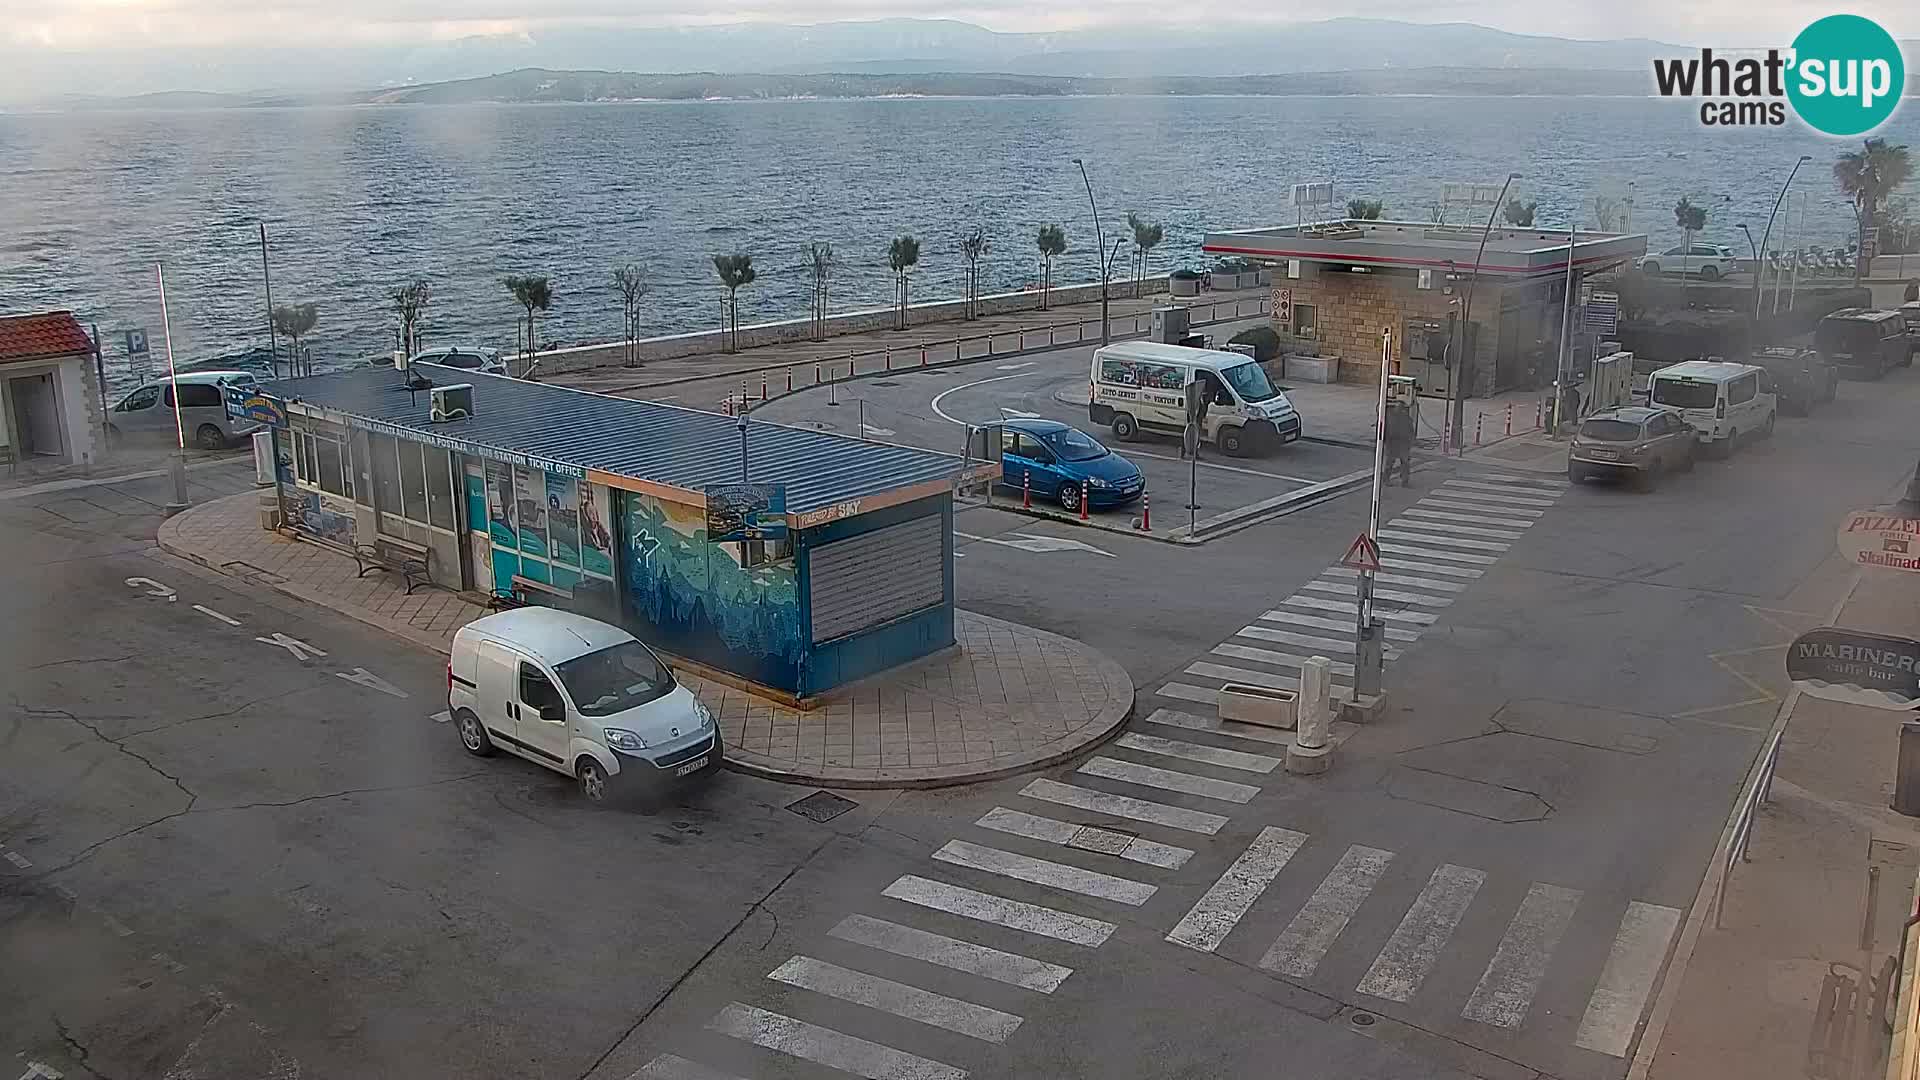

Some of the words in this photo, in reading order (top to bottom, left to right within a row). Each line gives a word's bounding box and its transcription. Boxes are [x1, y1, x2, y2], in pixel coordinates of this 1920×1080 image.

[437, 437, 467, 451] POSTAJA
[478, 446, 493, 458] BUS
[494, 449, 526, 465] STATION
[528, 457, 554, 472] TICKET
[556, 464, 582, 478] OFFICE
[1868, 667, 1896, 681] bar
